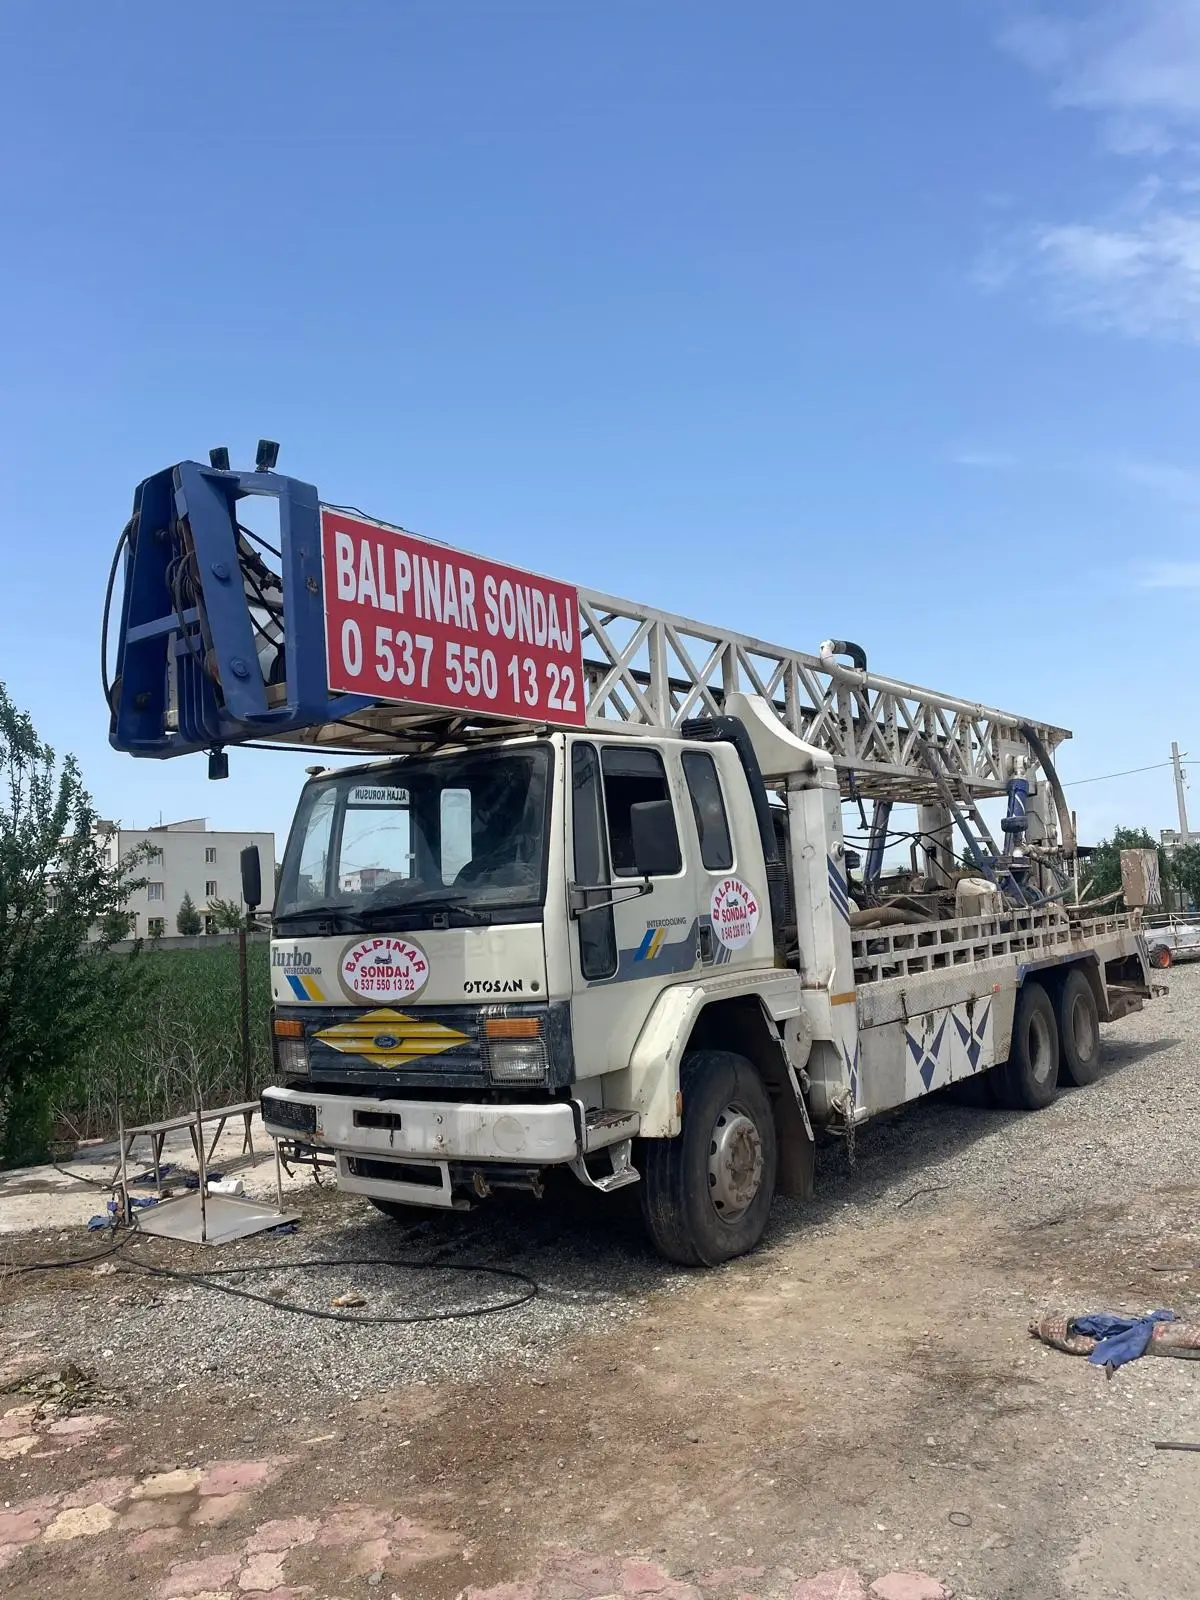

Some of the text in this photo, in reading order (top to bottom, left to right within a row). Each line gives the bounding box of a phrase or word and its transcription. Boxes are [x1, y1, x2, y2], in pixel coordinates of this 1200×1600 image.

[335, 531, 573, 653] BALPINAR SONDAJ
[341, 619, 577, 712] 0 537 550 13 22
[713, 881, 757, 921] BALPINAR
[646, 917, 687, 928] INTERCOOLING
[721, 906, 747, 923] SONDAJ
[272, 946, 312, 966] Turbo
[345, 939, 426, 973] BALPINAR
[283, 967, 322, 975] INTERCOOLING
[360, 966, 409, 978] SONDAJ
[354, 979, 415, 990] 0 537 550 13 22
[463, 979, 523, 993] OTOSAN
